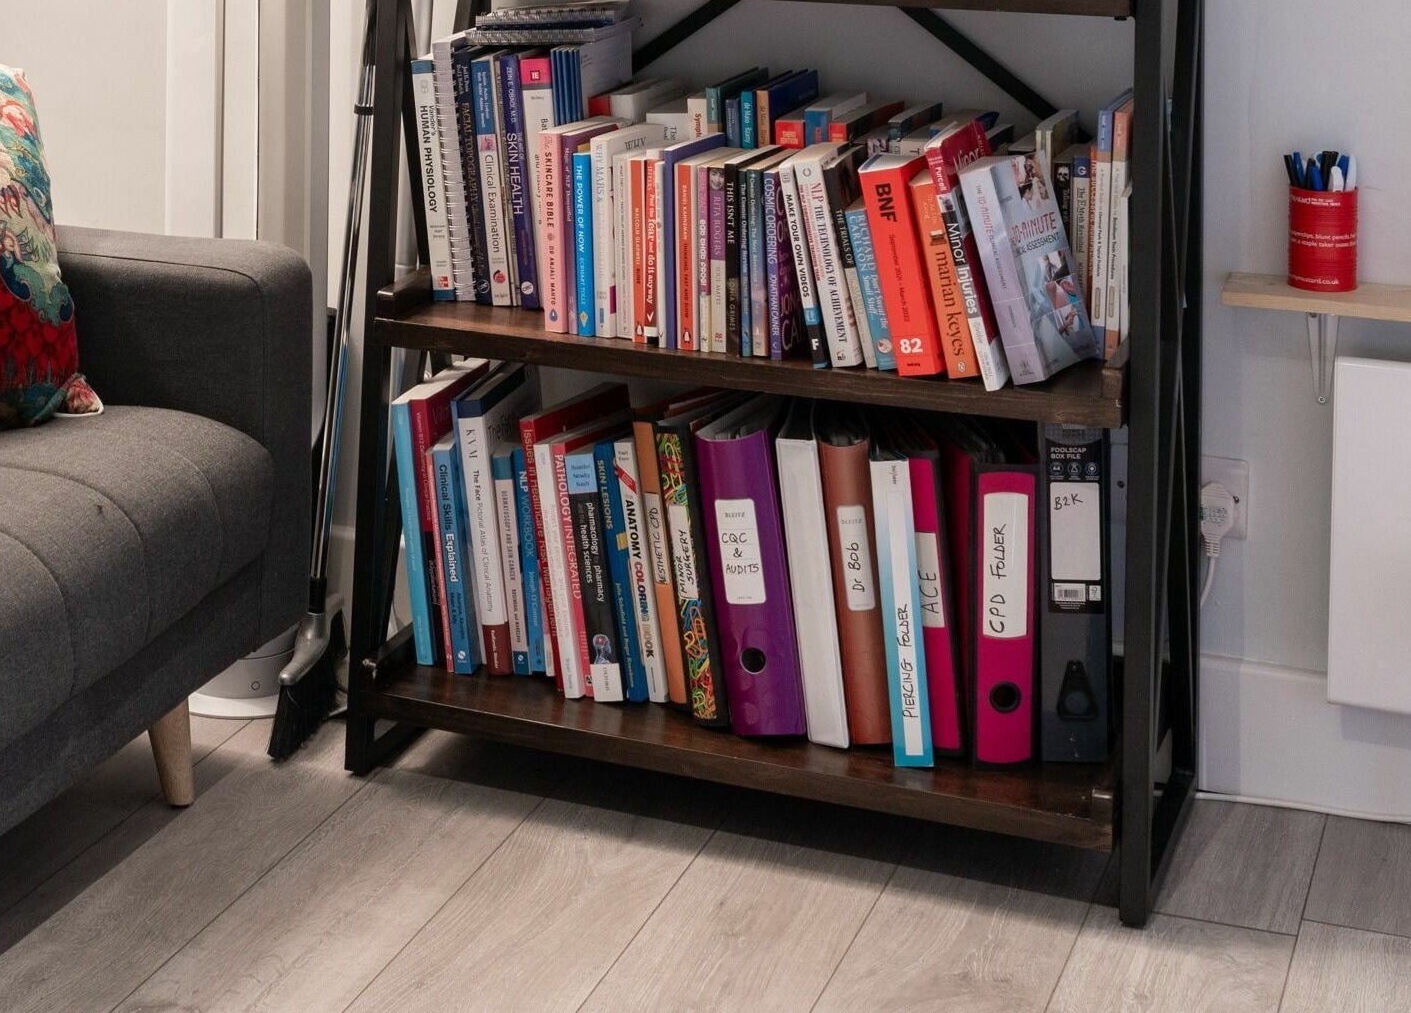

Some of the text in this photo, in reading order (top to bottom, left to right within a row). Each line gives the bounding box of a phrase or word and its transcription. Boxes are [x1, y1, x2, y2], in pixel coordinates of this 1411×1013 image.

[419, 105, 438, 213] HUMAN PHYSIOLOGY
[506, 132, 523, 215] SKIN HEALTH
[934, 167, 947, 191] Purcell
[484, 154, 500, 253] Clinical Examination
[726, 182, 734, 201] THIS
[727, 202, 735, 228] ISN'T
[578, 218, 584, 229] OF
[727, 230, 734, 245] ME
[786, 194, 810, 298] MAKE YOUR OWN VIDEOS
[836, 210, 854, 264] THE TRIALS OF
[875, 182, 898, 223] BNF
[889, 233, 899, 265] September
[899, 287, 907, 308] March
[978, 196, 994, 234] 10-MINUTE
[993, 255, 1007, 289] ASSESSMENT
[1026, 232, 1060, 253] ASSESSMENT
[764, 178, 780, 337] COSMIC ORDERING JONATHAN CAINER
[811, 182, 848, 344] NLP THE TECHNOLOGY OF ACHIEVEMENT
[947, 222, 977, 315] Minor Injuries
[935, 251, 965, 356] marian keyes
[899, 338, 923, 354] 82
[523, 428, 534, 464] Issues
[439, 463, 450, 501] Clinical
[597, 459, 614, 530] SKIN LESIONS
[1053, 493, 1083, 511] B2K
[442, 503, 452, 530] Skills
[476, 503, 484, 529] Pictorial
[519, 470, 535, 557] NLP WORKBOOK
[553, 454, 571, 525] PATHOLOGY
[566, 527, 582, 599] INTEGRATED
[722, 532, 748, 544] CQC
[445, 533, 459, 583] Explained
[482, 558, 490, 581] Clinical
[580, 524, 593, 583] health sciences
[586, 501, 605, 602] pharmacology pharmacy
[679, 554, 688, 598] MINOR
[681, 529, 695, 587] SURGERY
[725, 563, 760, 575] AUDITS
[733, 547, 743, 558] &
[846, 542, 865, 593] Dr Bob
[485, 583, 494, 613] Anatomy
[625, 499, 655, 659] ANATOMY COLORING BOOK
[918, 571, 939, 614] ACE
[989, 523, 1007, 634] CPD FOLDER
[896, 603, 919, 718] PIERCING FOLDER
